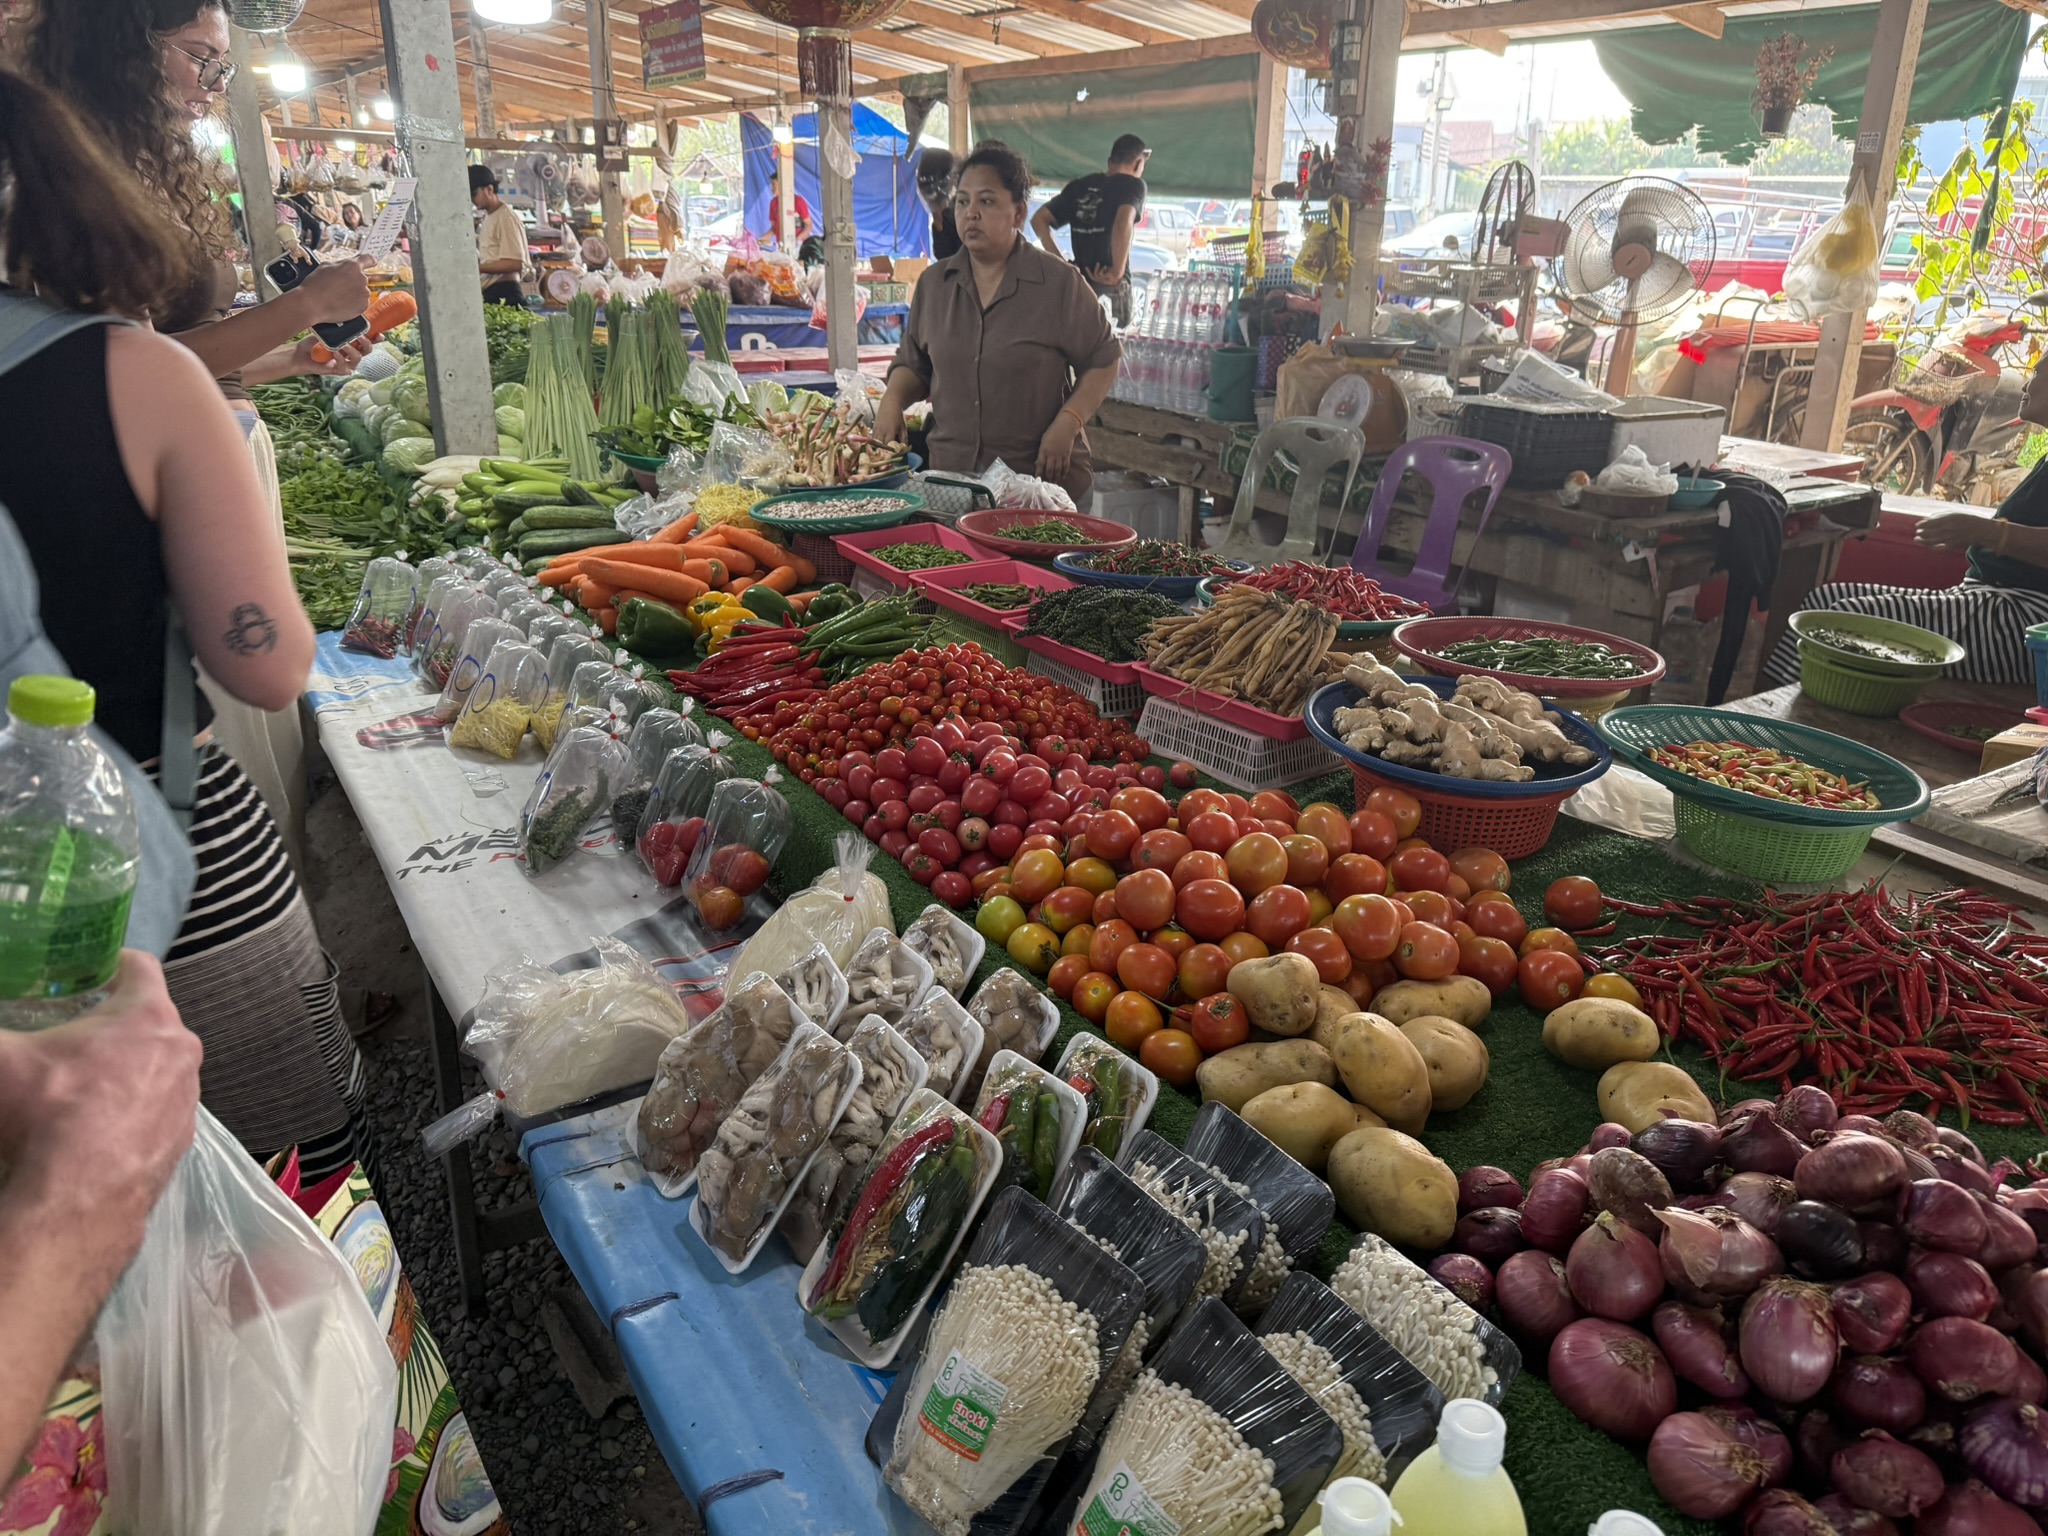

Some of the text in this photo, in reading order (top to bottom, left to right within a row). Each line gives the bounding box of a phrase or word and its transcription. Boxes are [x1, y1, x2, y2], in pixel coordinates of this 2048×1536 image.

[424, 831, 476, 846] ALL
[396, 856, 477, 880] THE
[952, 1399, 989, 1430] Enoki
